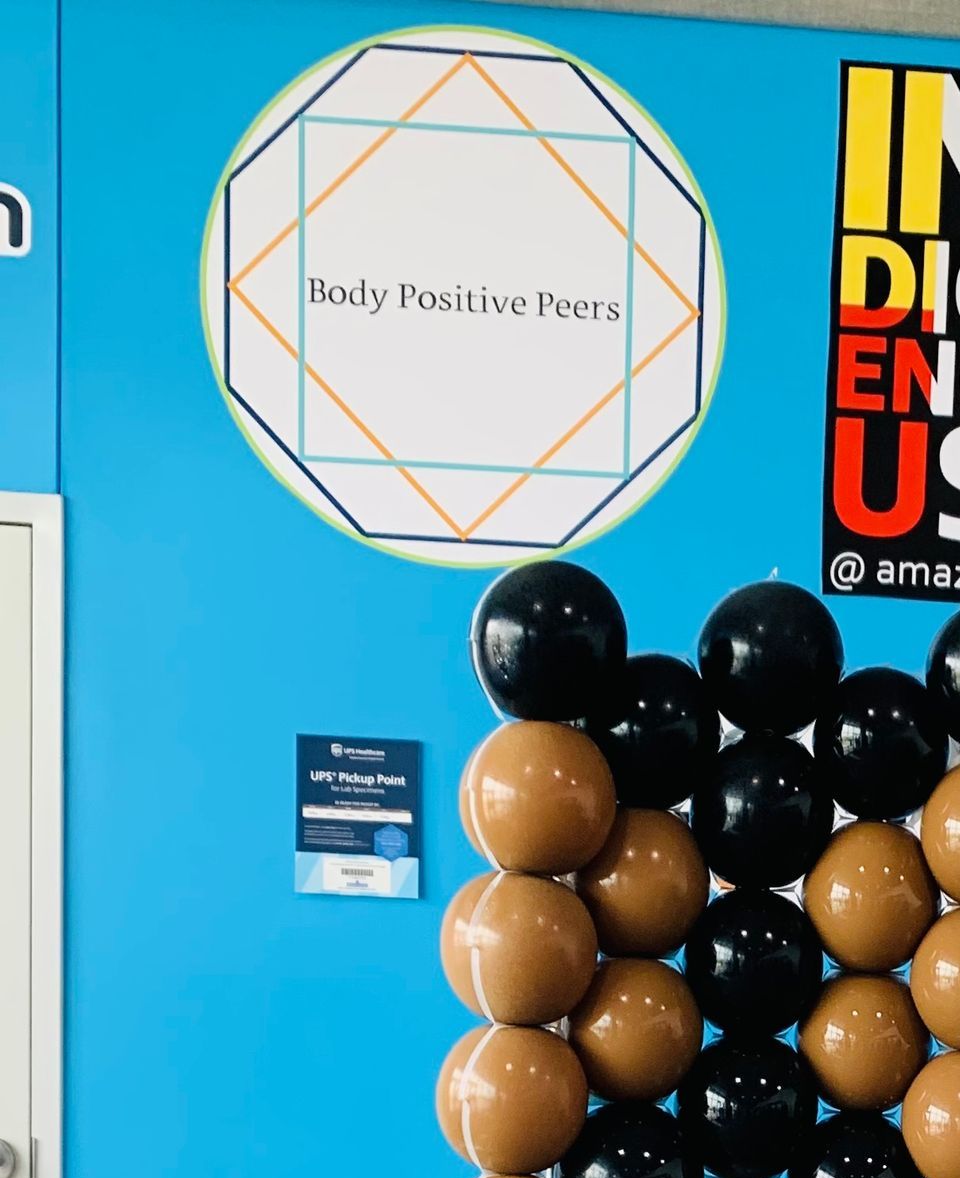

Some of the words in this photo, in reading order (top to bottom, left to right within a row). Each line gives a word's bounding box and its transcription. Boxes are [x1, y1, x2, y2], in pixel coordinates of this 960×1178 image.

[307, 277, 388, 315] Body
[398, 283, 526, 316] Positive
[536, 291, 620, 321] Peers
[830, 552, 865, 591] @
[338, 771, 375, 786] Pickup
[377, 773, 406, 786] Point
